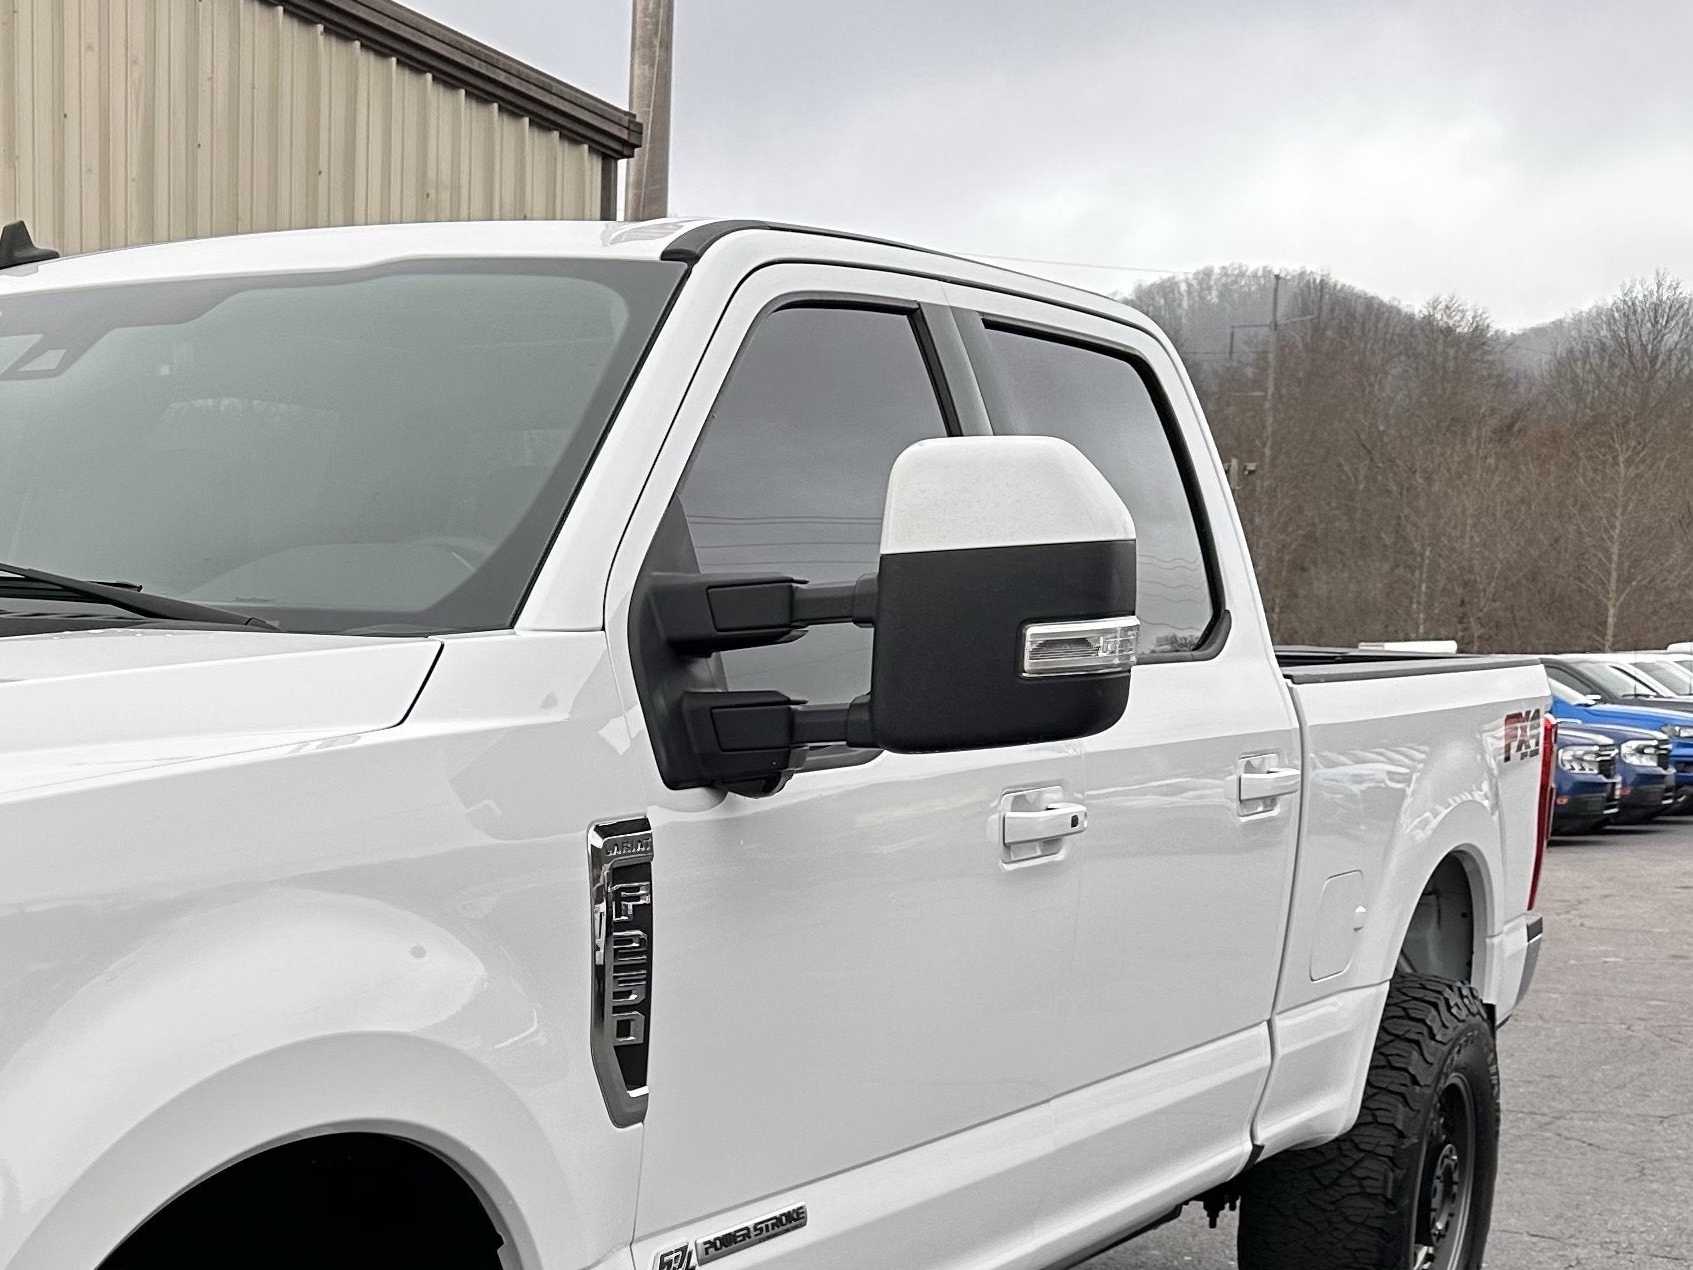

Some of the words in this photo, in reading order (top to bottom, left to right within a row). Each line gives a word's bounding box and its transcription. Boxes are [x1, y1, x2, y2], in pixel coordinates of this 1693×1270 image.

[611, 881, 650, 1047] F250
[702, 1226, 751, 1256] POWER
[753, 1206, 805, 1238] STROKE
